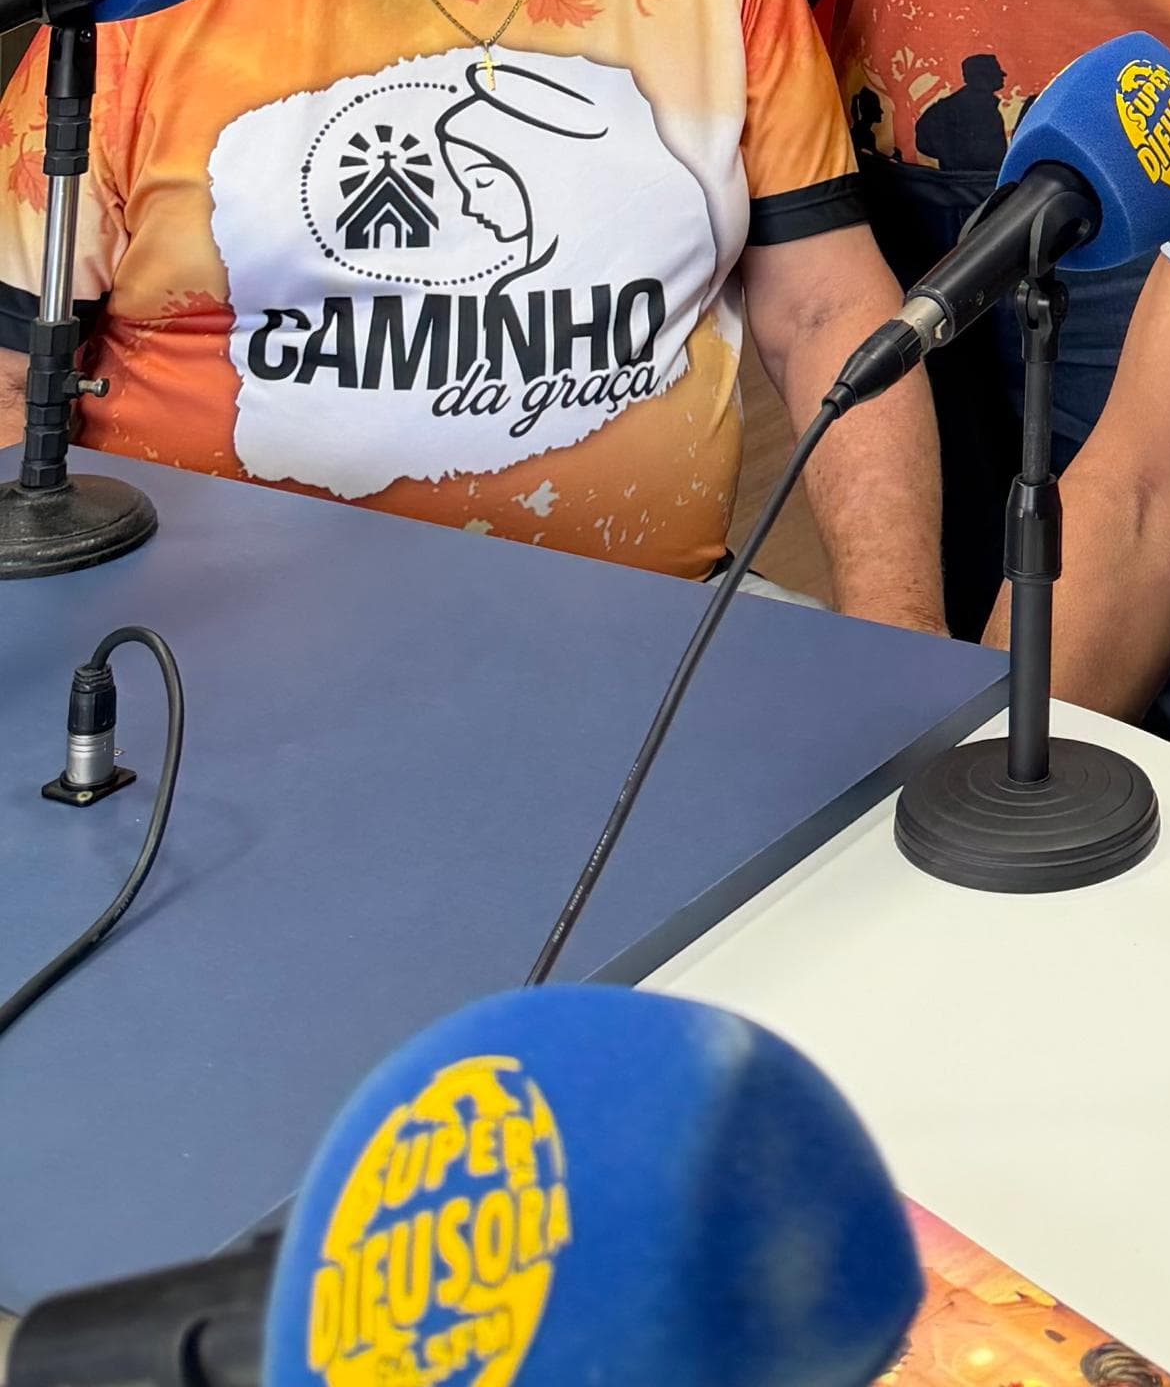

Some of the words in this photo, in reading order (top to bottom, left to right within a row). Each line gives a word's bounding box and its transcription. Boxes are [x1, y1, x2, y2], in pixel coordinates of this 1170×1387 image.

[247, 277, 667, 392] CAMINHO
[431, 363, 511, 417] da
[509, 363, 661, 439] graça
